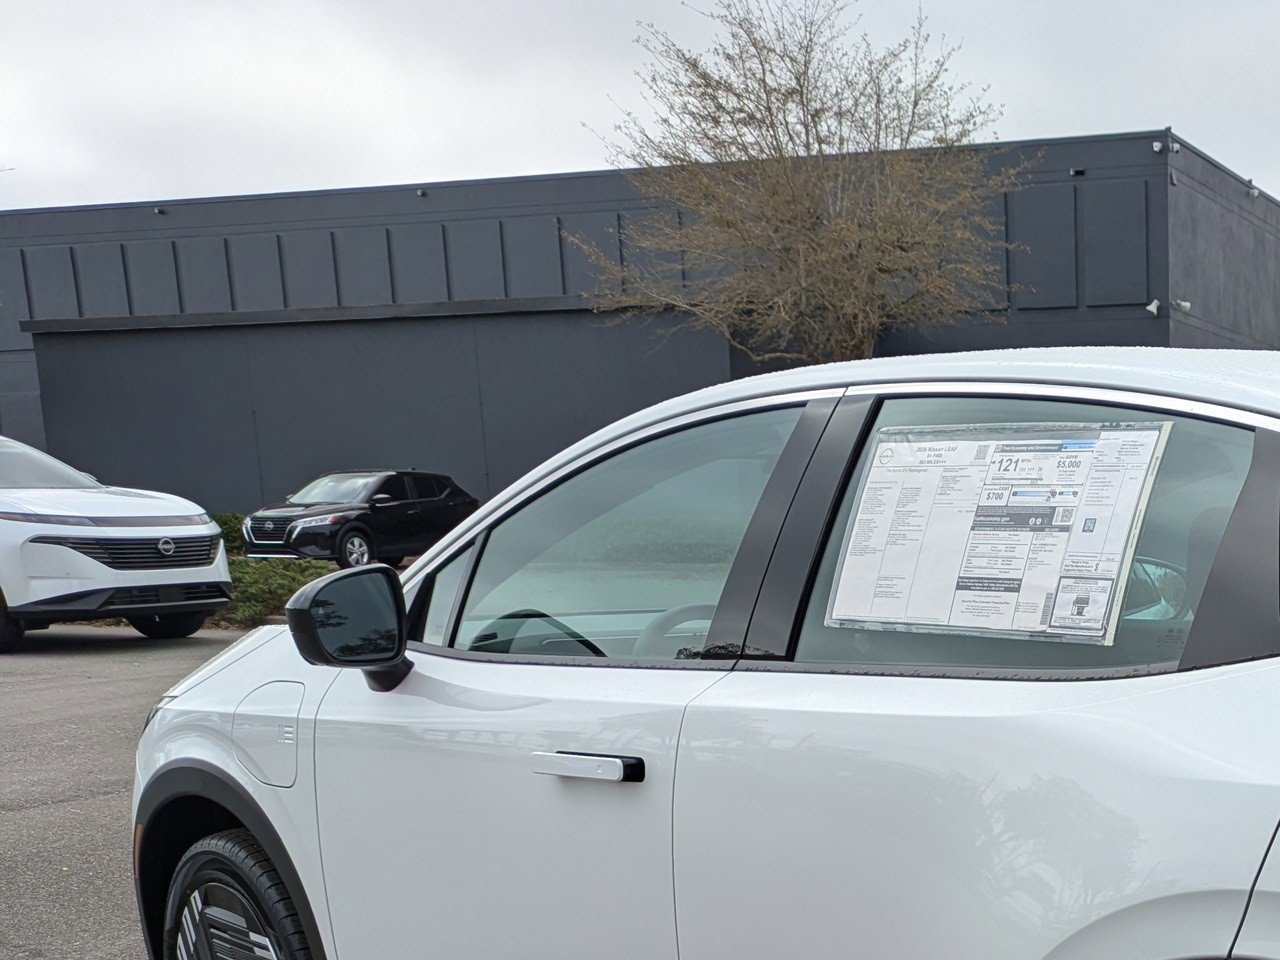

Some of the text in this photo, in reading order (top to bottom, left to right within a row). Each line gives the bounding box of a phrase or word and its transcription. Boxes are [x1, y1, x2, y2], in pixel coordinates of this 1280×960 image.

[997, 458, 1021, 473] 121
[1056, 460, 1082, 470] $5,000
[986, 492, 1004, 501] $700
